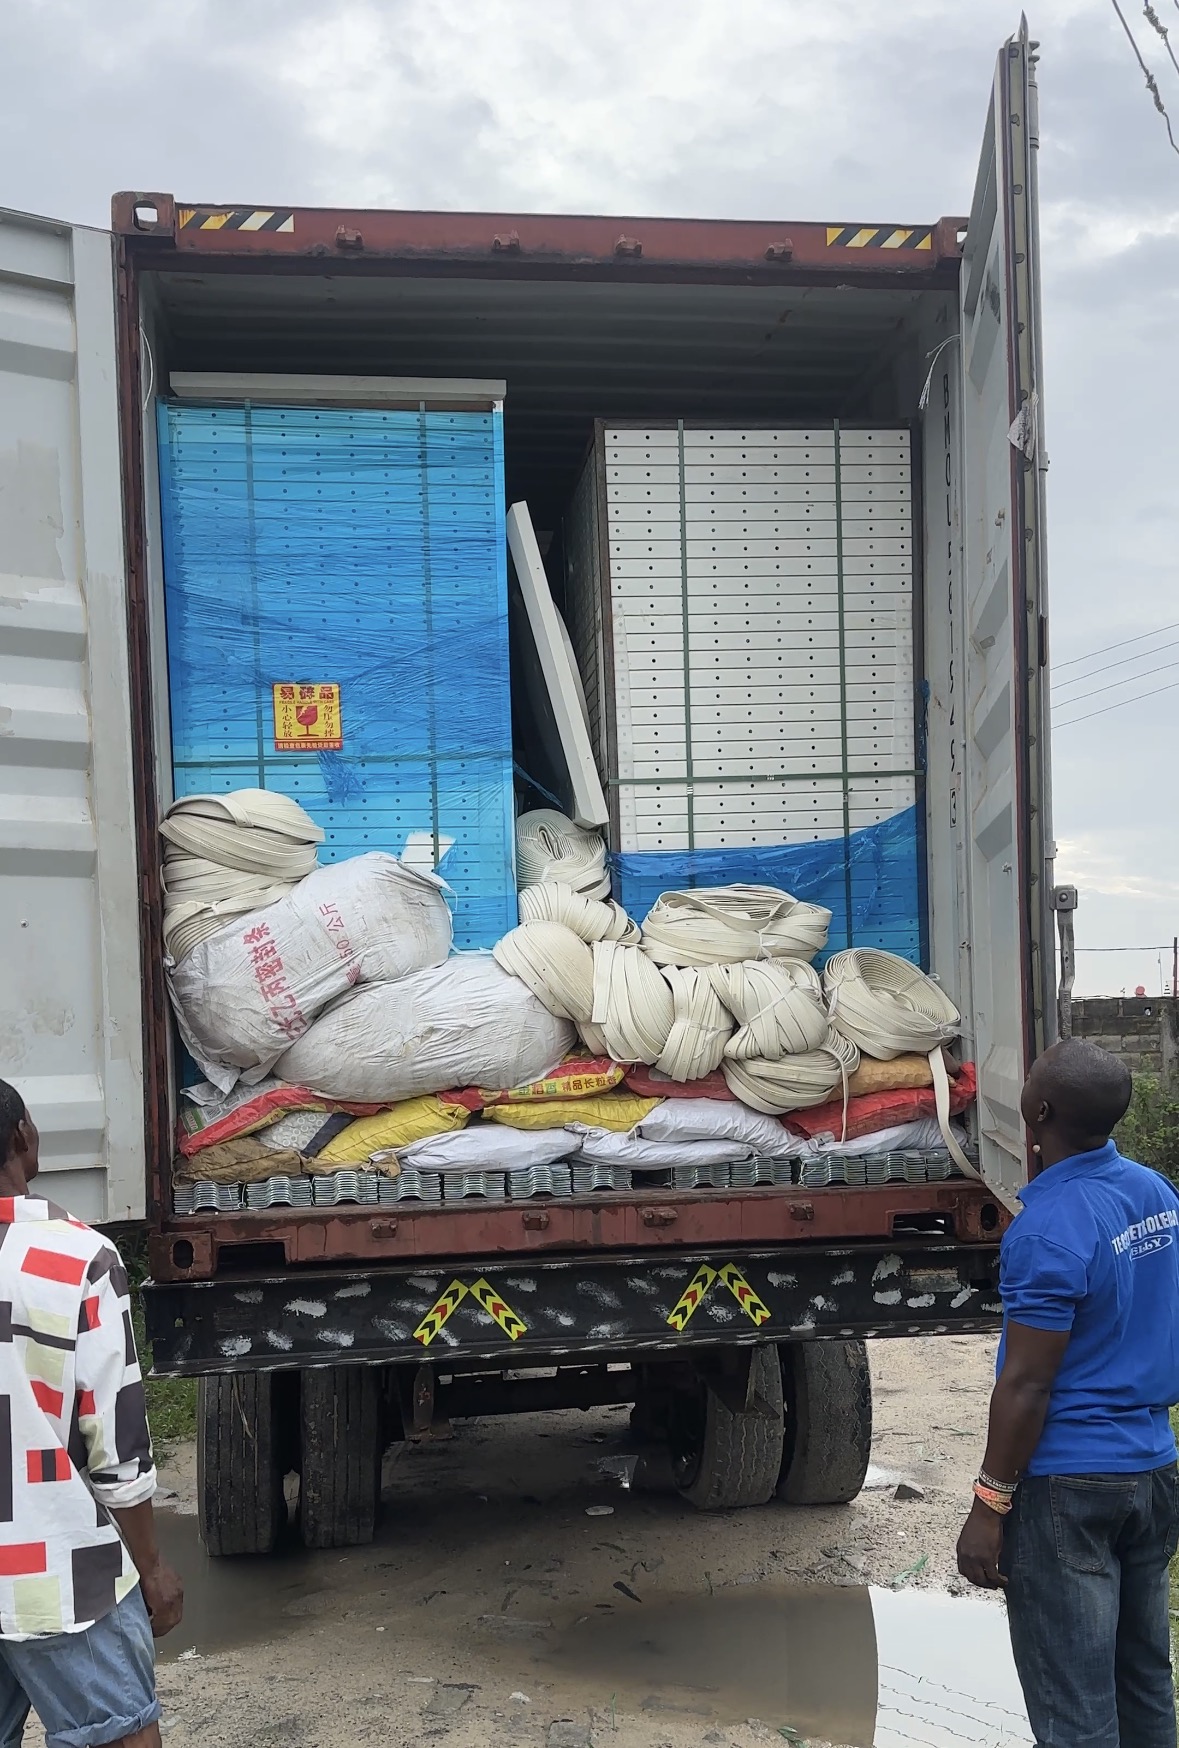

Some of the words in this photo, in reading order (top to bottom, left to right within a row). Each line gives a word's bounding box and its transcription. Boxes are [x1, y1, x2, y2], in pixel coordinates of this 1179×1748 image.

[279, 686, 334, 699] 易碎品
[282, 705, 293, 738] 小心轻放
[323, 705, 335, 738] 勿压勿摔
[319, 902, 344, 932] 公斤
[561, 1075, 617, 1091] 精品长粒香
